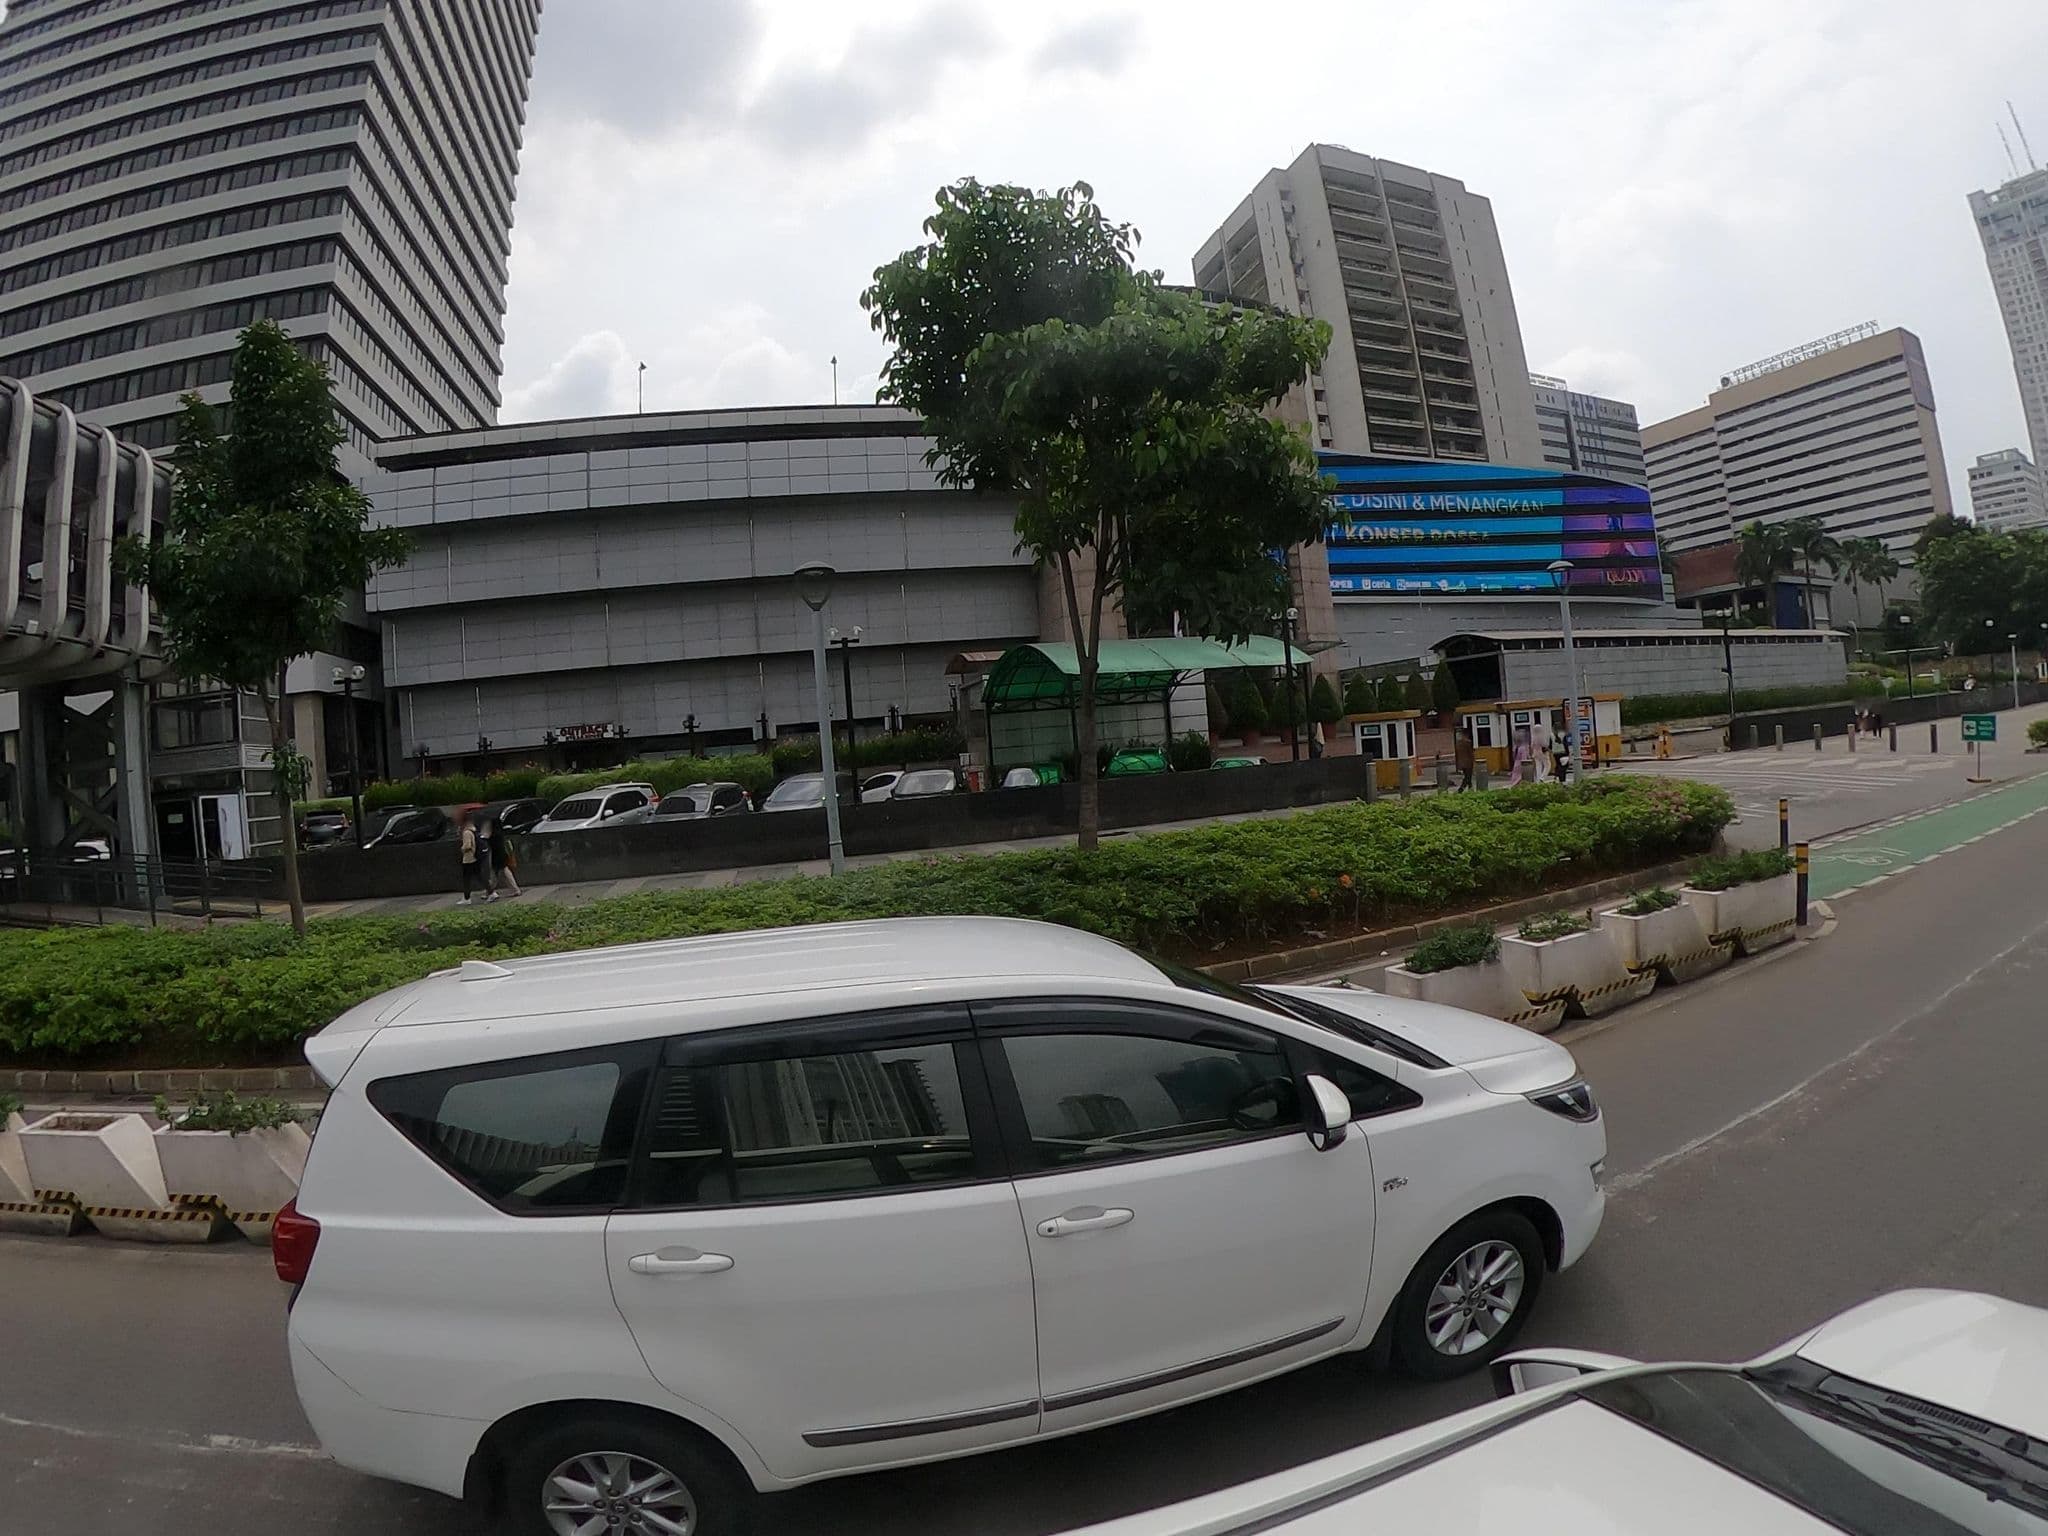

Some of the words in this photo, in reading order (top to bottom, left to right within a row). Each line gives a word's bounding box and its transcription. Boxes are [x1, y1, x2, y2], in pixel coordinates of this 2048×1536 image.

[1352, 494, 1407, 510] DISINI
[1412, 494, 1425, 511] &
[1429, 494, 1545, 514] MENANGKAN
